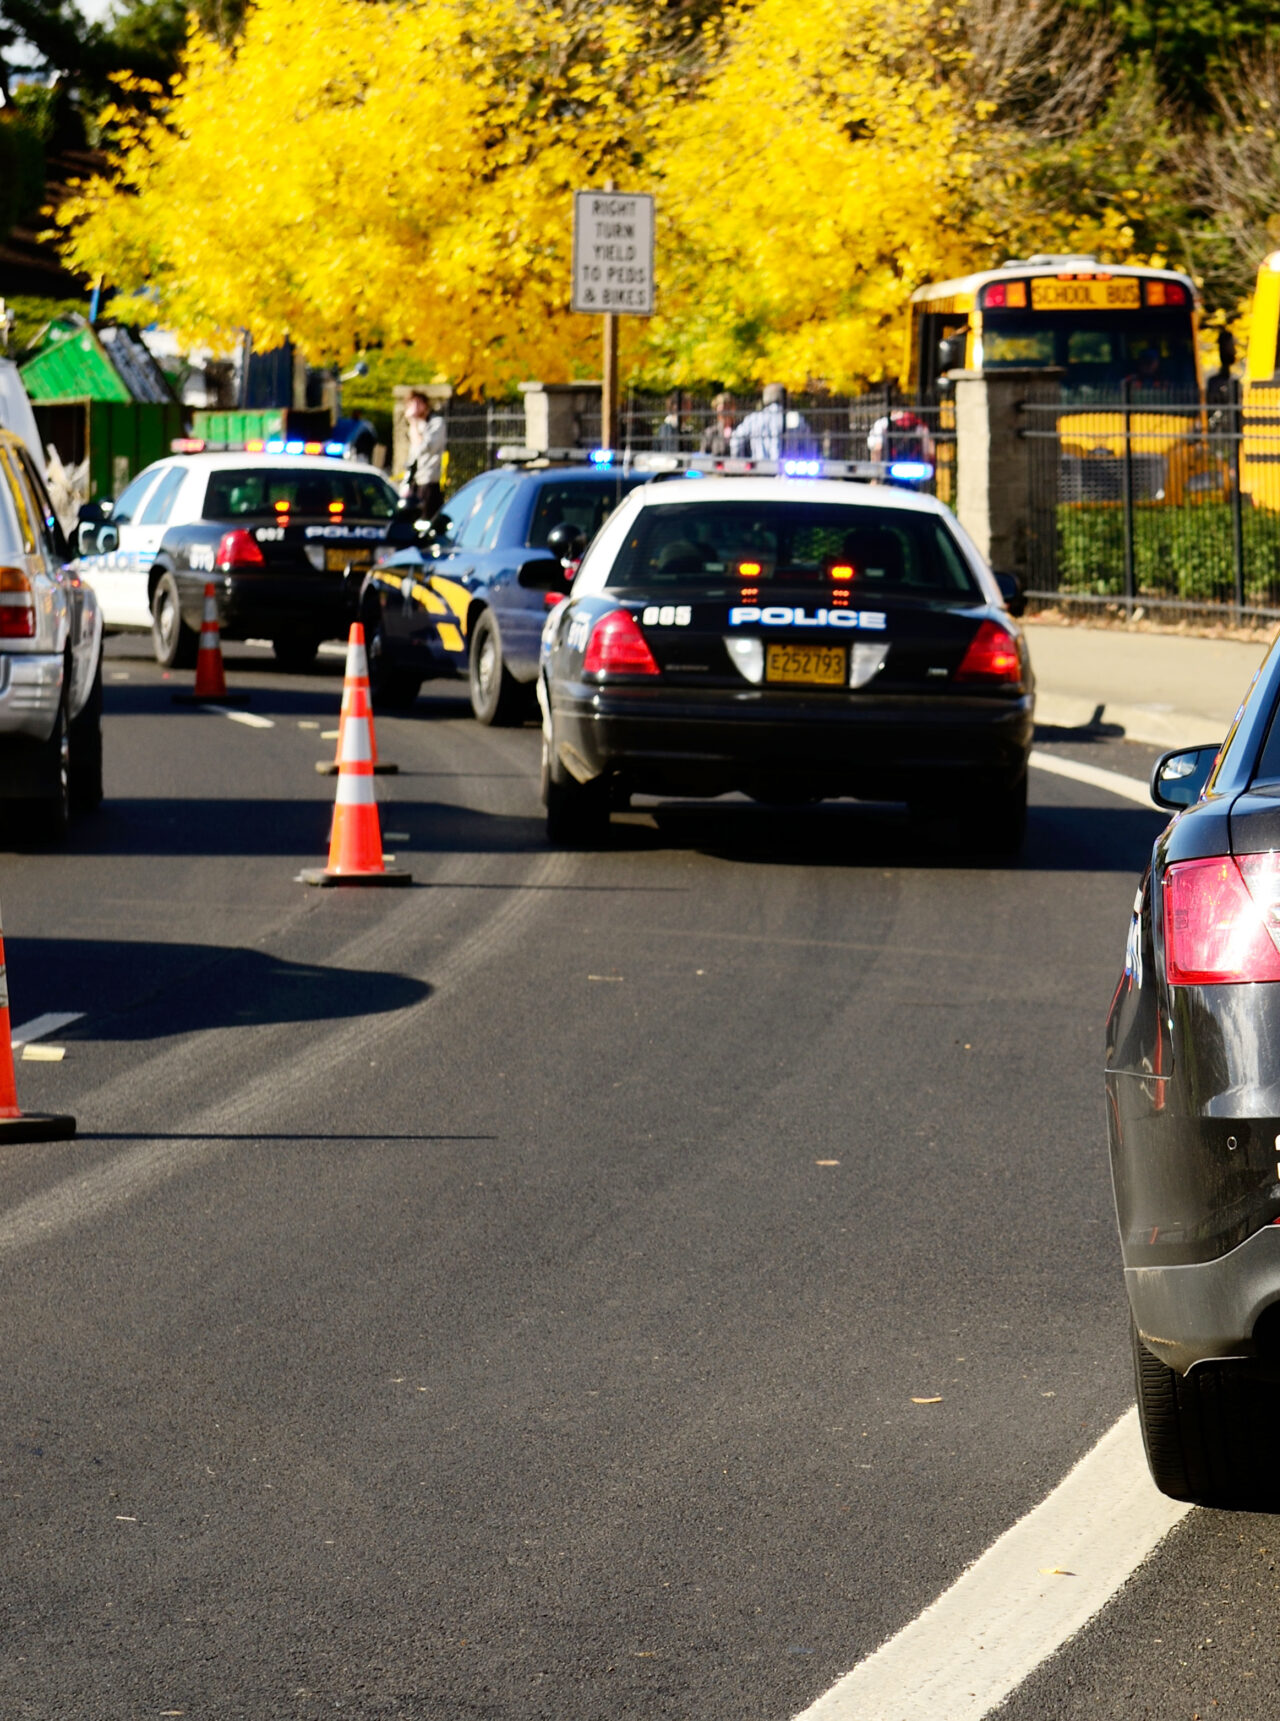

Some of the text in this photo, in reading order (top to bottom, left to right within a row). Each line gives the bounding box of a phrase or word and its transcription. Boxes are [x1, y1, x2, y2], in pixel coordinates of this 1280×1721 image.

[592, 199, 636, 216] RIGHT
[596, 222, 635, 239] TURN
[593, 245, 637, 262] YIELD
[583, 265, 602, 282] TO
[1032, 284, 1140, 305] SCHOOL BUS
[729, 607, 887, 630] POLICE
[771, 652, 843, 675] E252793
